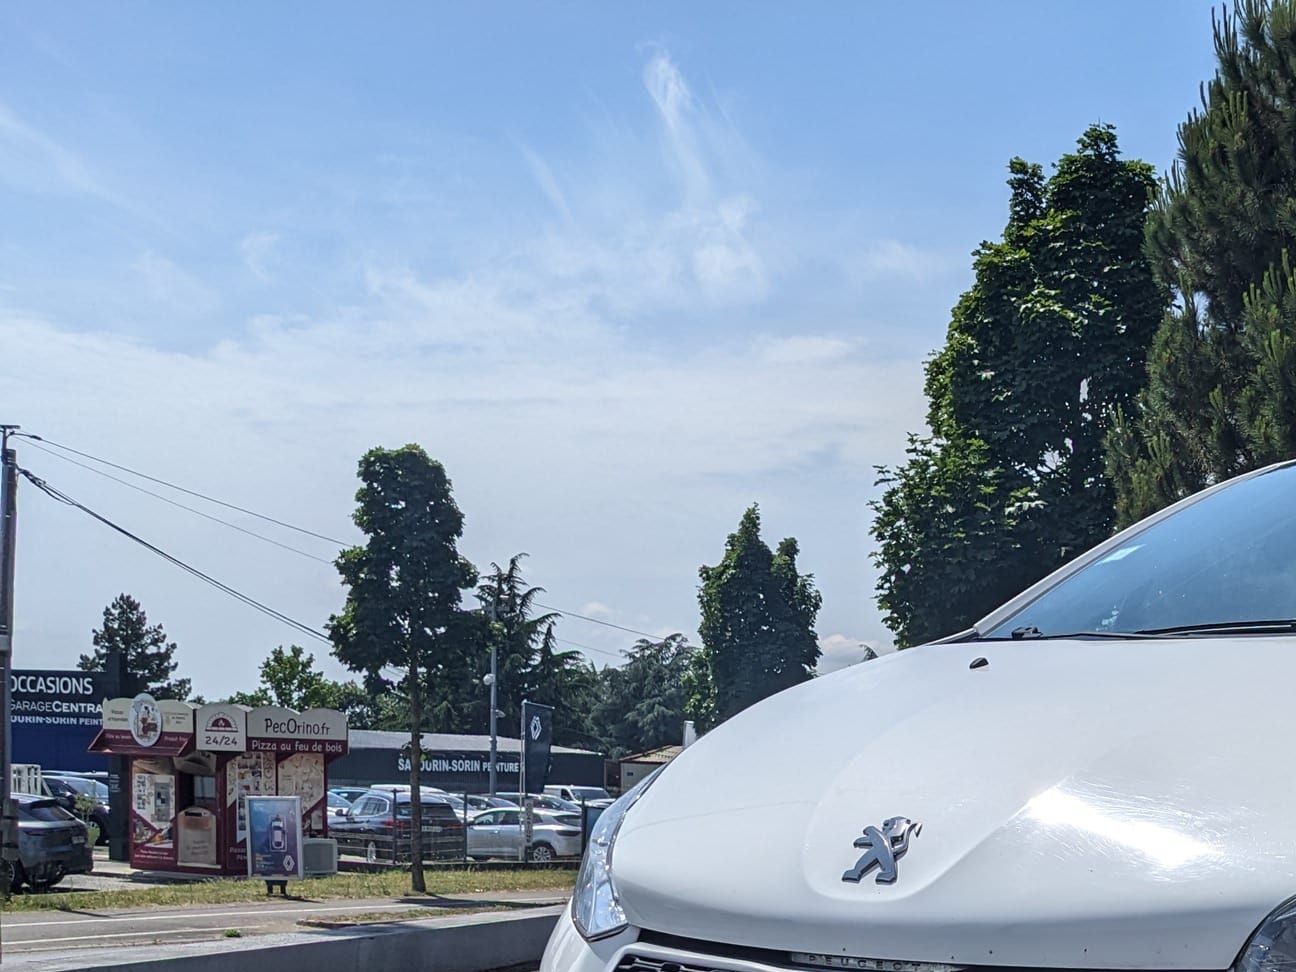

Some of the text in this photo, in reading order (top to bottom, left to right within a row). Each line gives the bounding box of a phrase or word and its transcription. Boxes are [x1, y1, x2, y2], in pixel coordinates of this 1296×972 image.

[10, 675, 94, 695] OCCASIONS
[205, 735, 238, 746] 24/24
[252, 740, 342, 752] Pizza au feu de bois
[398, 758, 519, 773] SAOURIN-SORIN PENTURE
[809, 954, 921, 971] PEUGEOT
